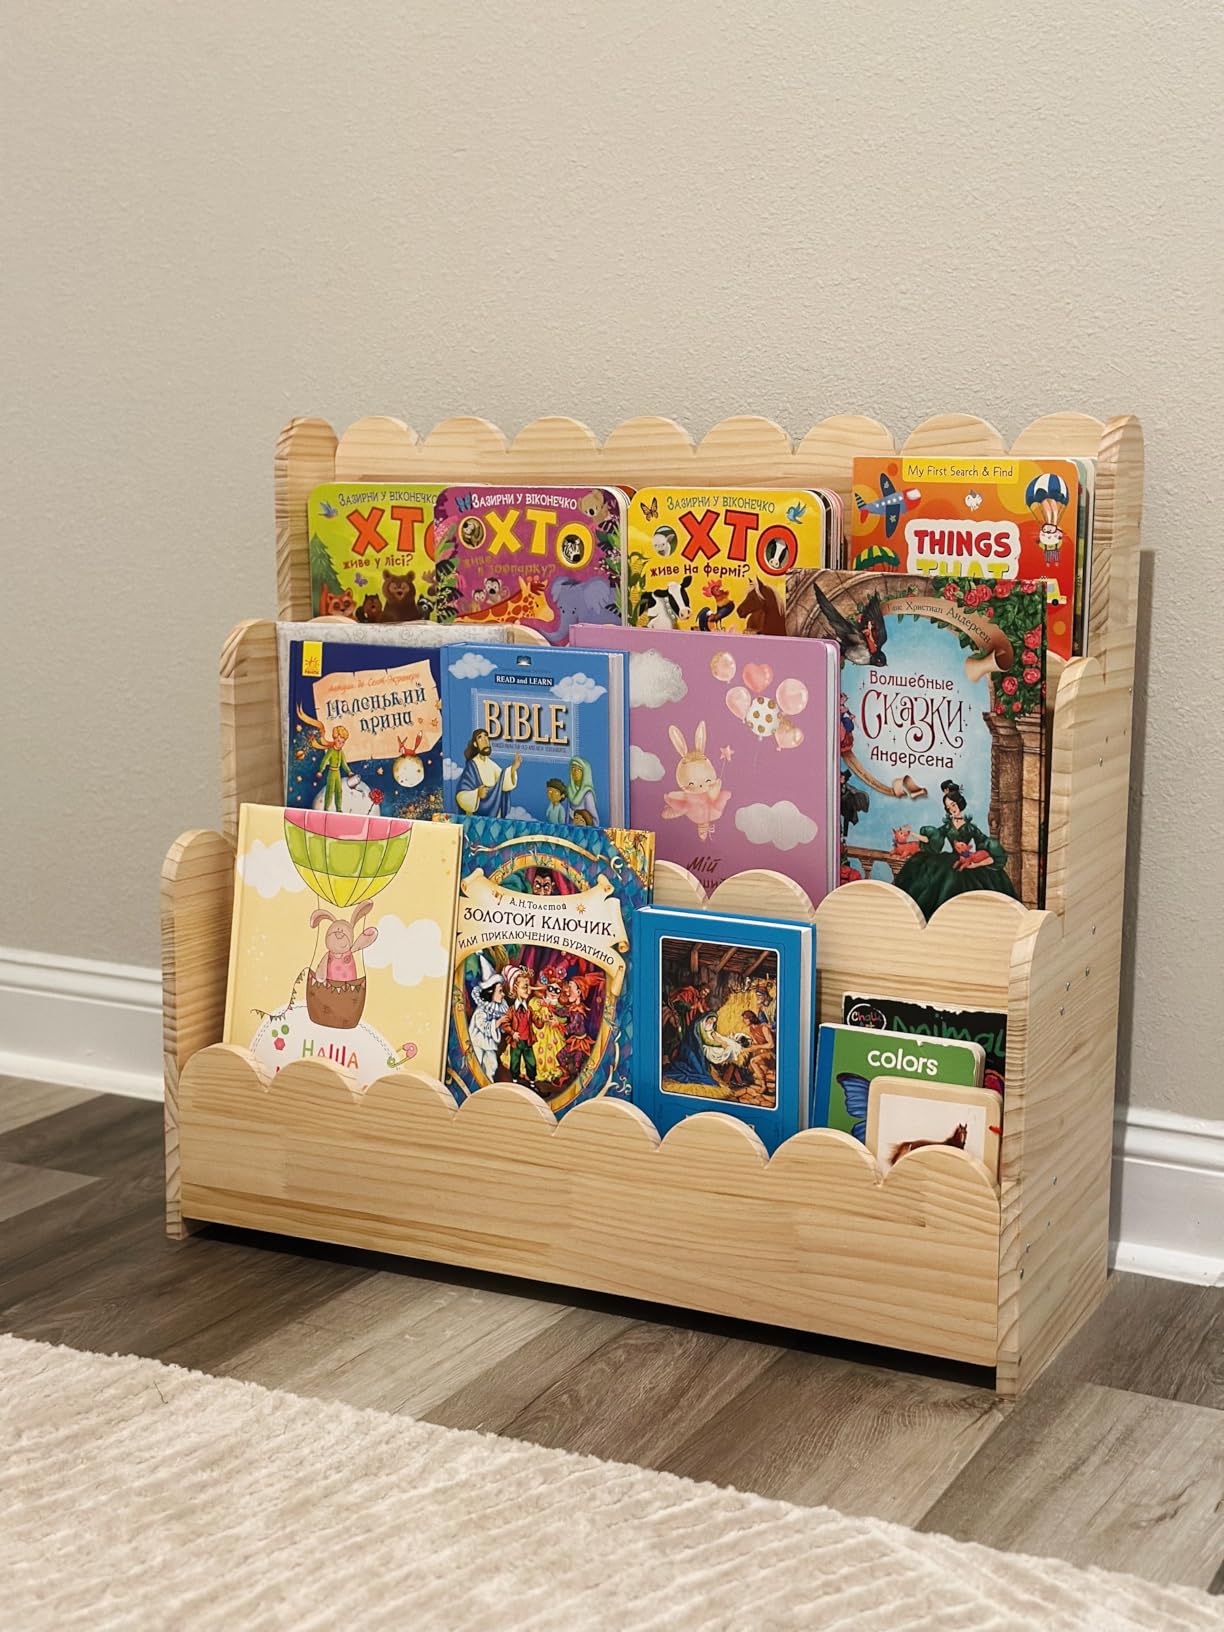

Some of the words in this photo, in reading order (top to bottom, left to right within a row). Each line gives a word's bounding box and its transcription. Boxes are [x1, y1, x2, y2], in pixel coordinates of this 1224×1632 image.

[907, 465, 924, 477] My
[927, 465, 947, 476] First
[950, 466, 979, 477] Search
[982, 467, 990, 476] &
[993, 467, 1013, 477] Find
[485, 508, 594, 569] ХТО
[678, 509, 799, 576] ХТО
[913, 530, 1012, 558] THINGS
[650, 566, 680, 578] живе
[703, 563, 751, 578] фермі?
[946, 607, 992, 643] Андерсен
[496, 675, 516, 685] READ
[516, 677, 528, 685] and
[529, 677, 553, 686] LEARN
[869, 670, 954, 691] Волшебные
[483, 700, 569, 744] BIBLE
[870, 745, 954, 768] Андерсена
[463, 907, 536, 928] ЗОЛОТОЙ
[458, 936, 478, 949] ИЛИ
[481, 930, 560, 946] ПРИКЛЮЧЕНИЯ
[562, 938, 615, 966] БУРАТИНО
[867, 1048, 938, 1076] colors
